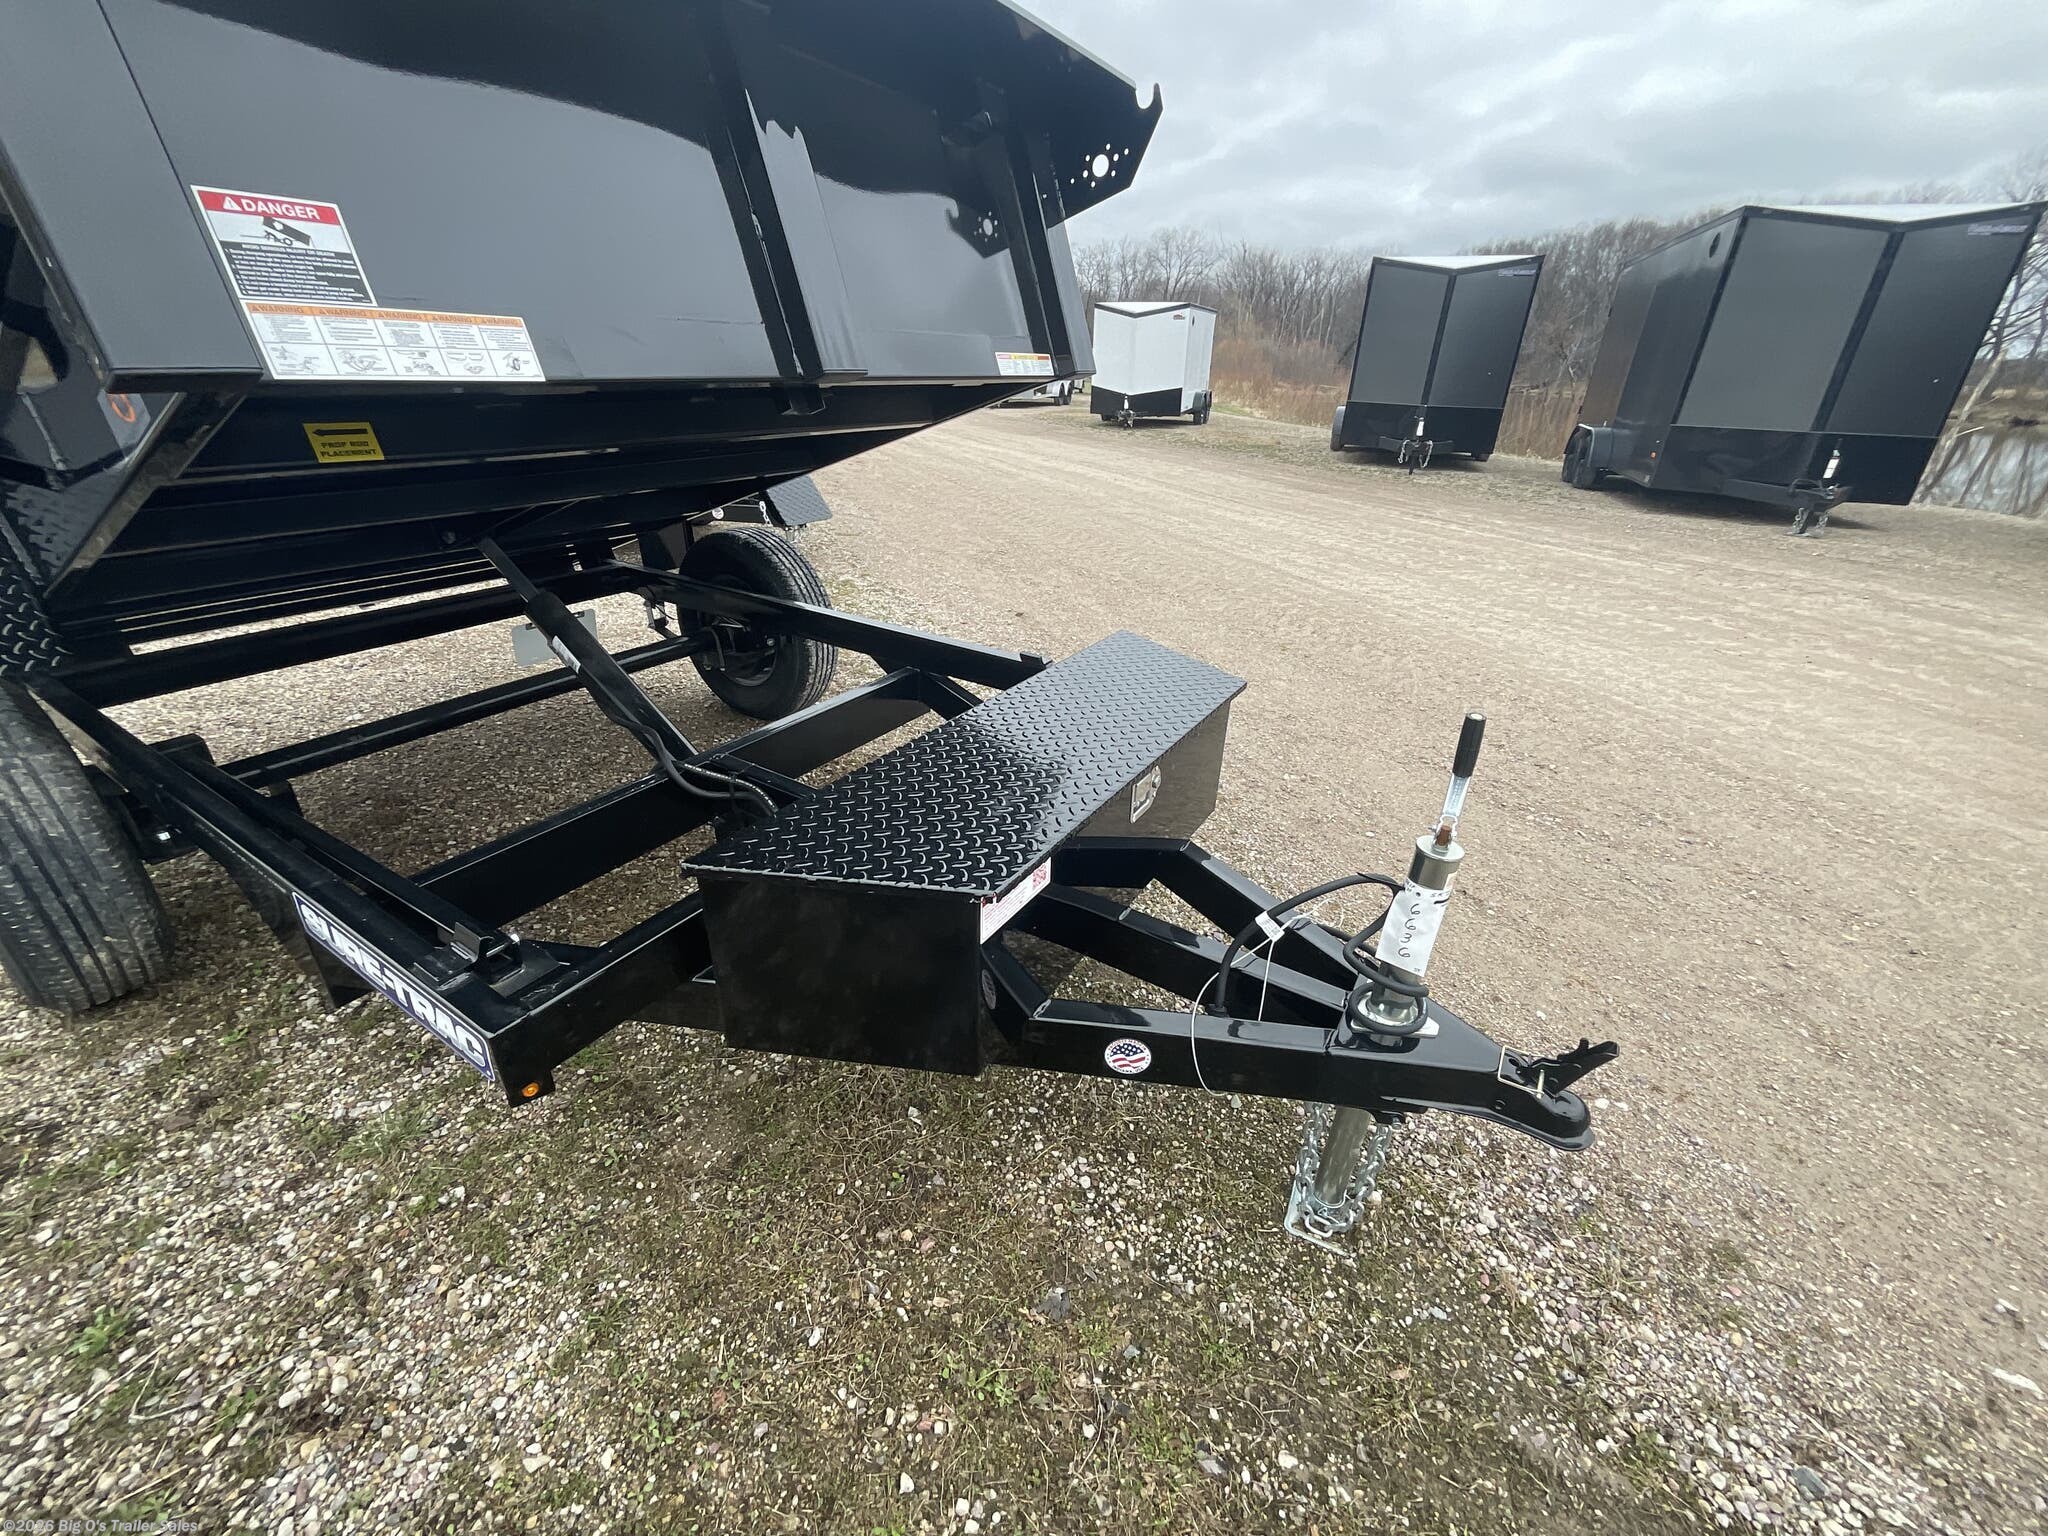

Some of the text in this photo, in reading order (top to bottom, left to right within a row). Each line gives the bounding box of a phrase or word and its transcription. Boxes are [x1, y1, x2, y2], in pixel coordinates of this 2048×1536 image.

[240, 198, 320, 219] DANGER
[257, 304, 304, 314] WARNING
[325, 307, 368, 317] WARNING
[385, 311, 422, 320] WARNING
[320, 441, 346, 449] PROP
[320, 449, 377, 457] PLACEMENT
[300, 904, 486, 1068] SURE-TRAC
